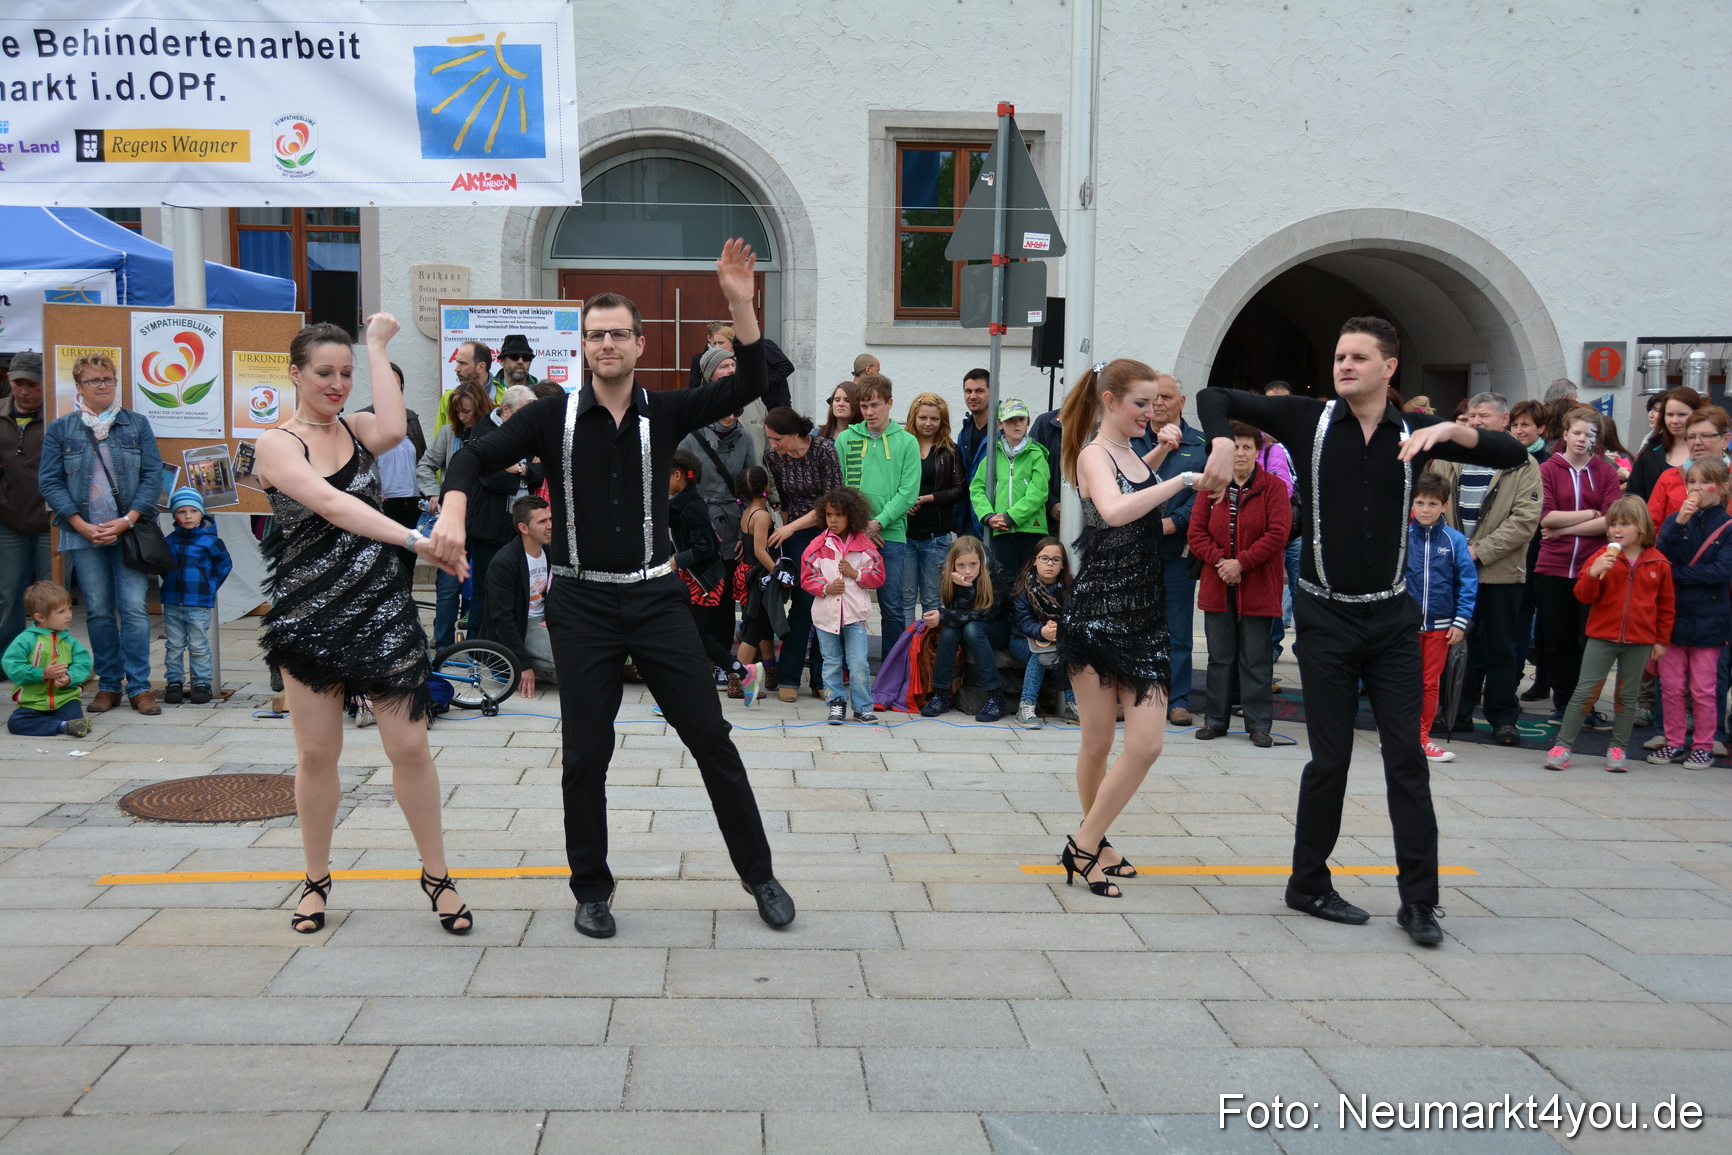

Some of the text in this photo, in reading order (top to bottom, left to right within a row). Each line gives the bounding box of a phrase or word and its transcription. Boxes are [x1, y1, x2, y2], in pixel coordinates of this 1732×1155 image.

[33, 27, 361, 60] Behindertenarbeit
[91, 71, 226, 102] i.d.OPf.
[19, 140, 60, 154] Land
[112, 135, 238, 157] Regens Wagner
[469, 307, 498, 315] Neumarkt
[502, 307, 518, 315] Offen
[531, 308, 554, 316] inklusiv
[140, 318, 217, 339] SYMPATHIEBLUME
